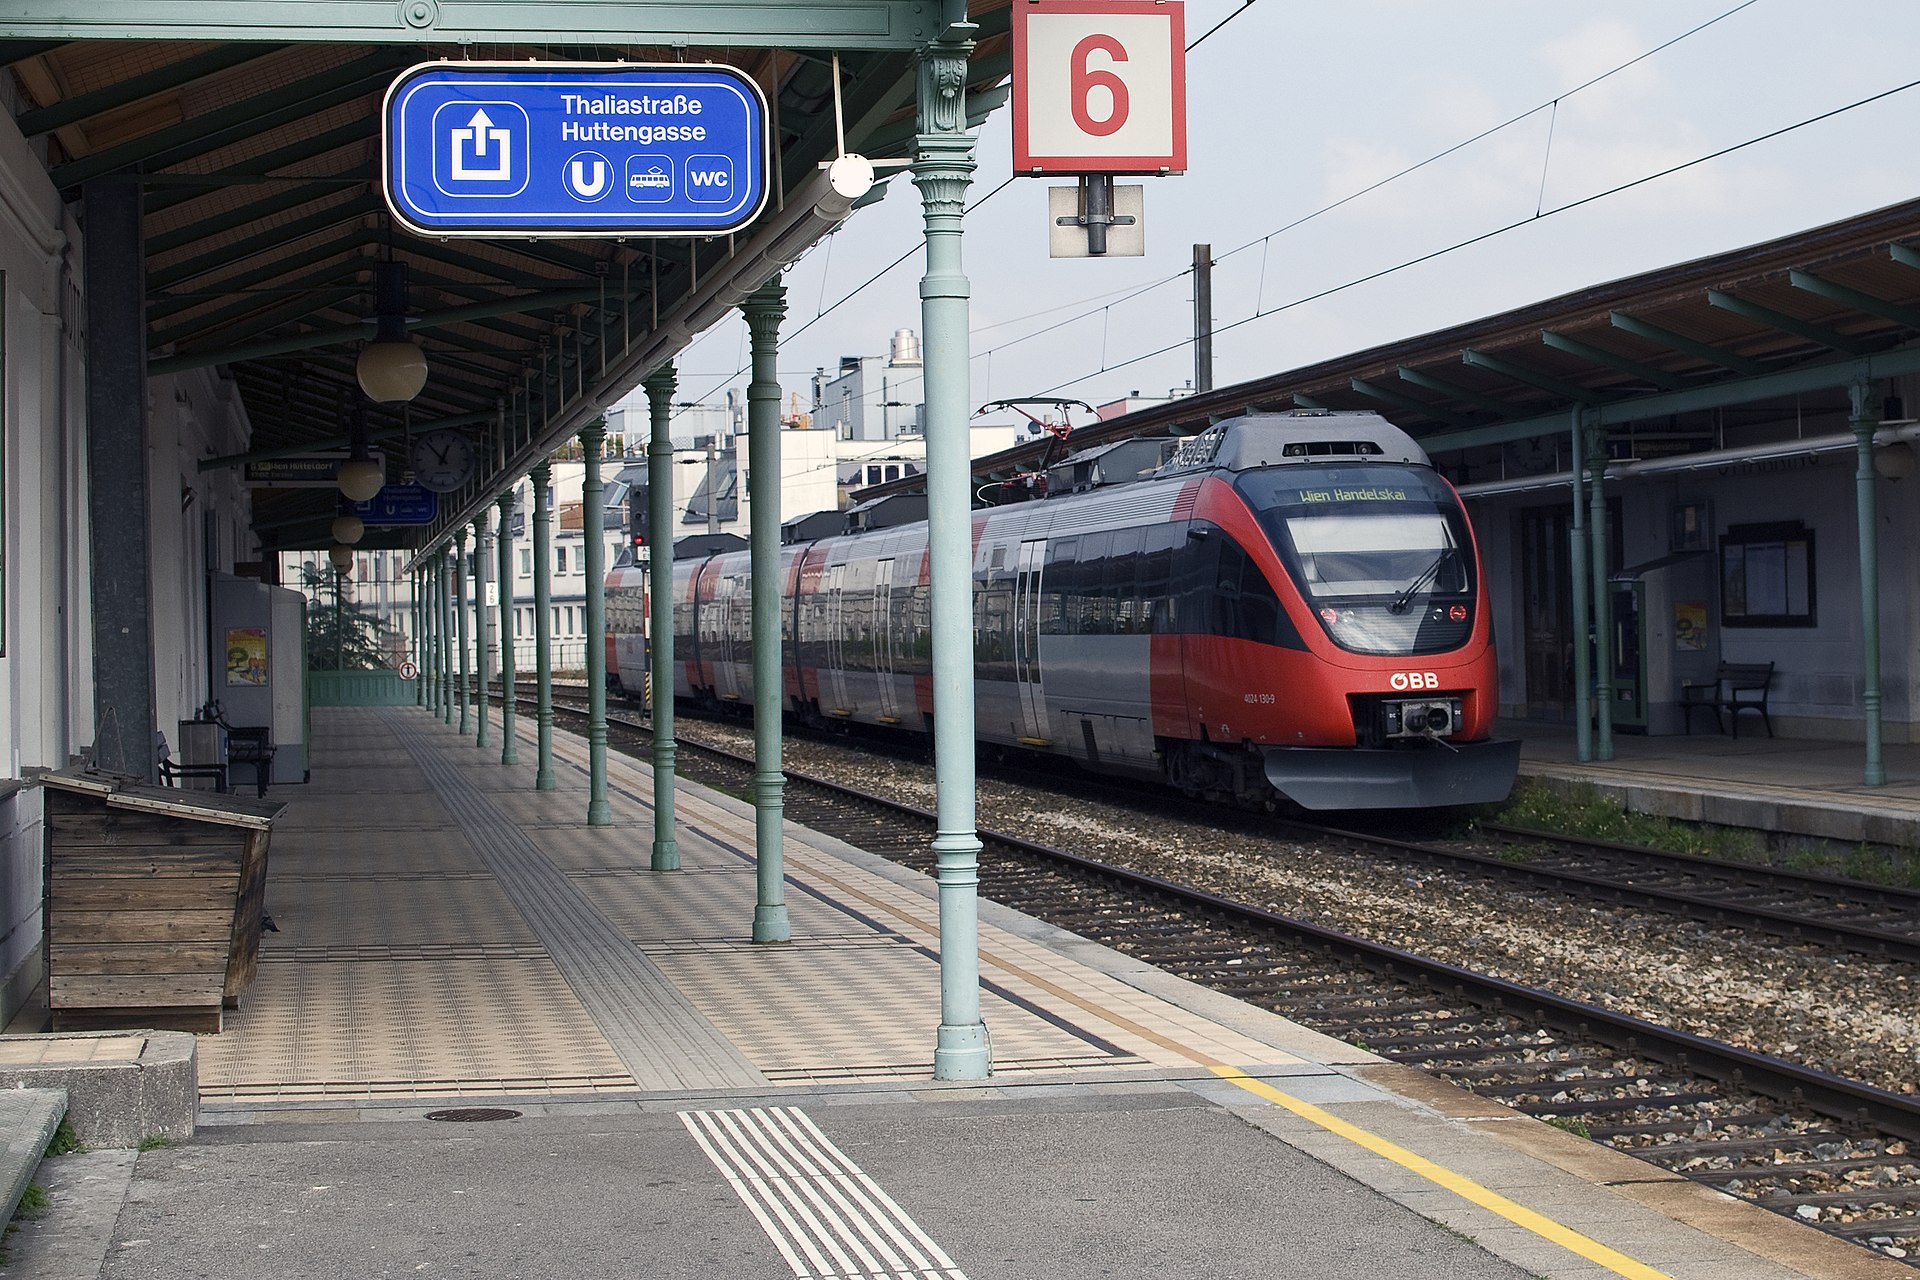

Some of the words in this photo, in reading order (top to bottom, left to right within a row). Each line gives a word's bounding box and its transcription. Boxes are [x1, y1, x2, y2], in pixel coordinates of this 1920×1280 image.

[1070, 33, 1129, 137] 6
[560, 95, 703, 115] Thaliastraße
[562, 122, 707, 145] Huttengasse
[571, 161, 605, 197] U
[1299, 489, 1332, 503] Wien
[1333, 488, 1406, 502] Handelskai
[1389, 671, 1439, 691] ÖBB
